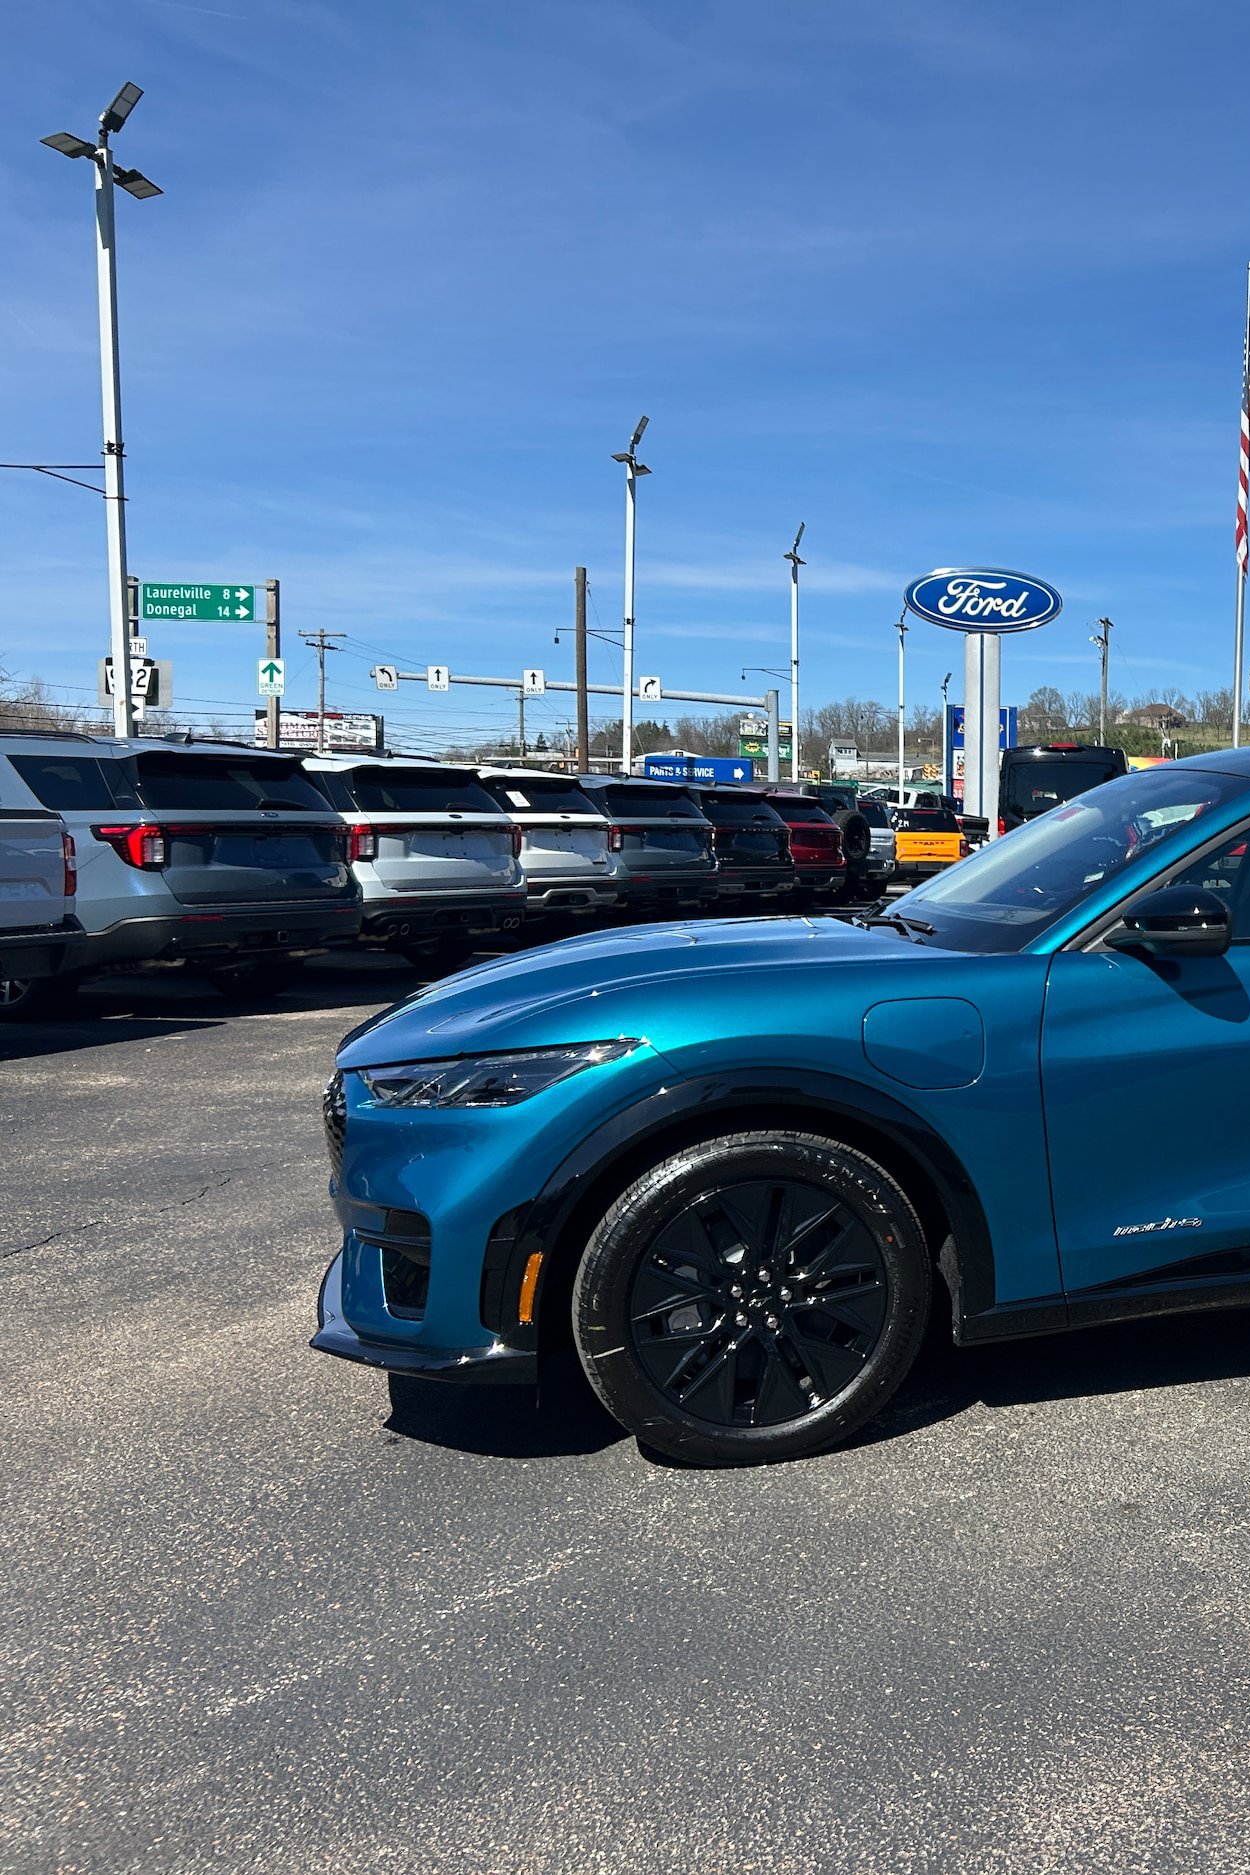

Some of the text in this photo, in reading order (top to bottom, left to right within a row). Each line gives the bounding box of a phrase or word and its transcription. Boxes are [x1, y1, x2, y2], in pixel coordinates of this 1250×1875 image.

[146, 587, 231, 600] Laurelville 8
[938, 578, 1029, 618] Ford
[146, 603, 231, 618] Donegal 14
[649, 766, 715, 778] PARTS & SERVICE
